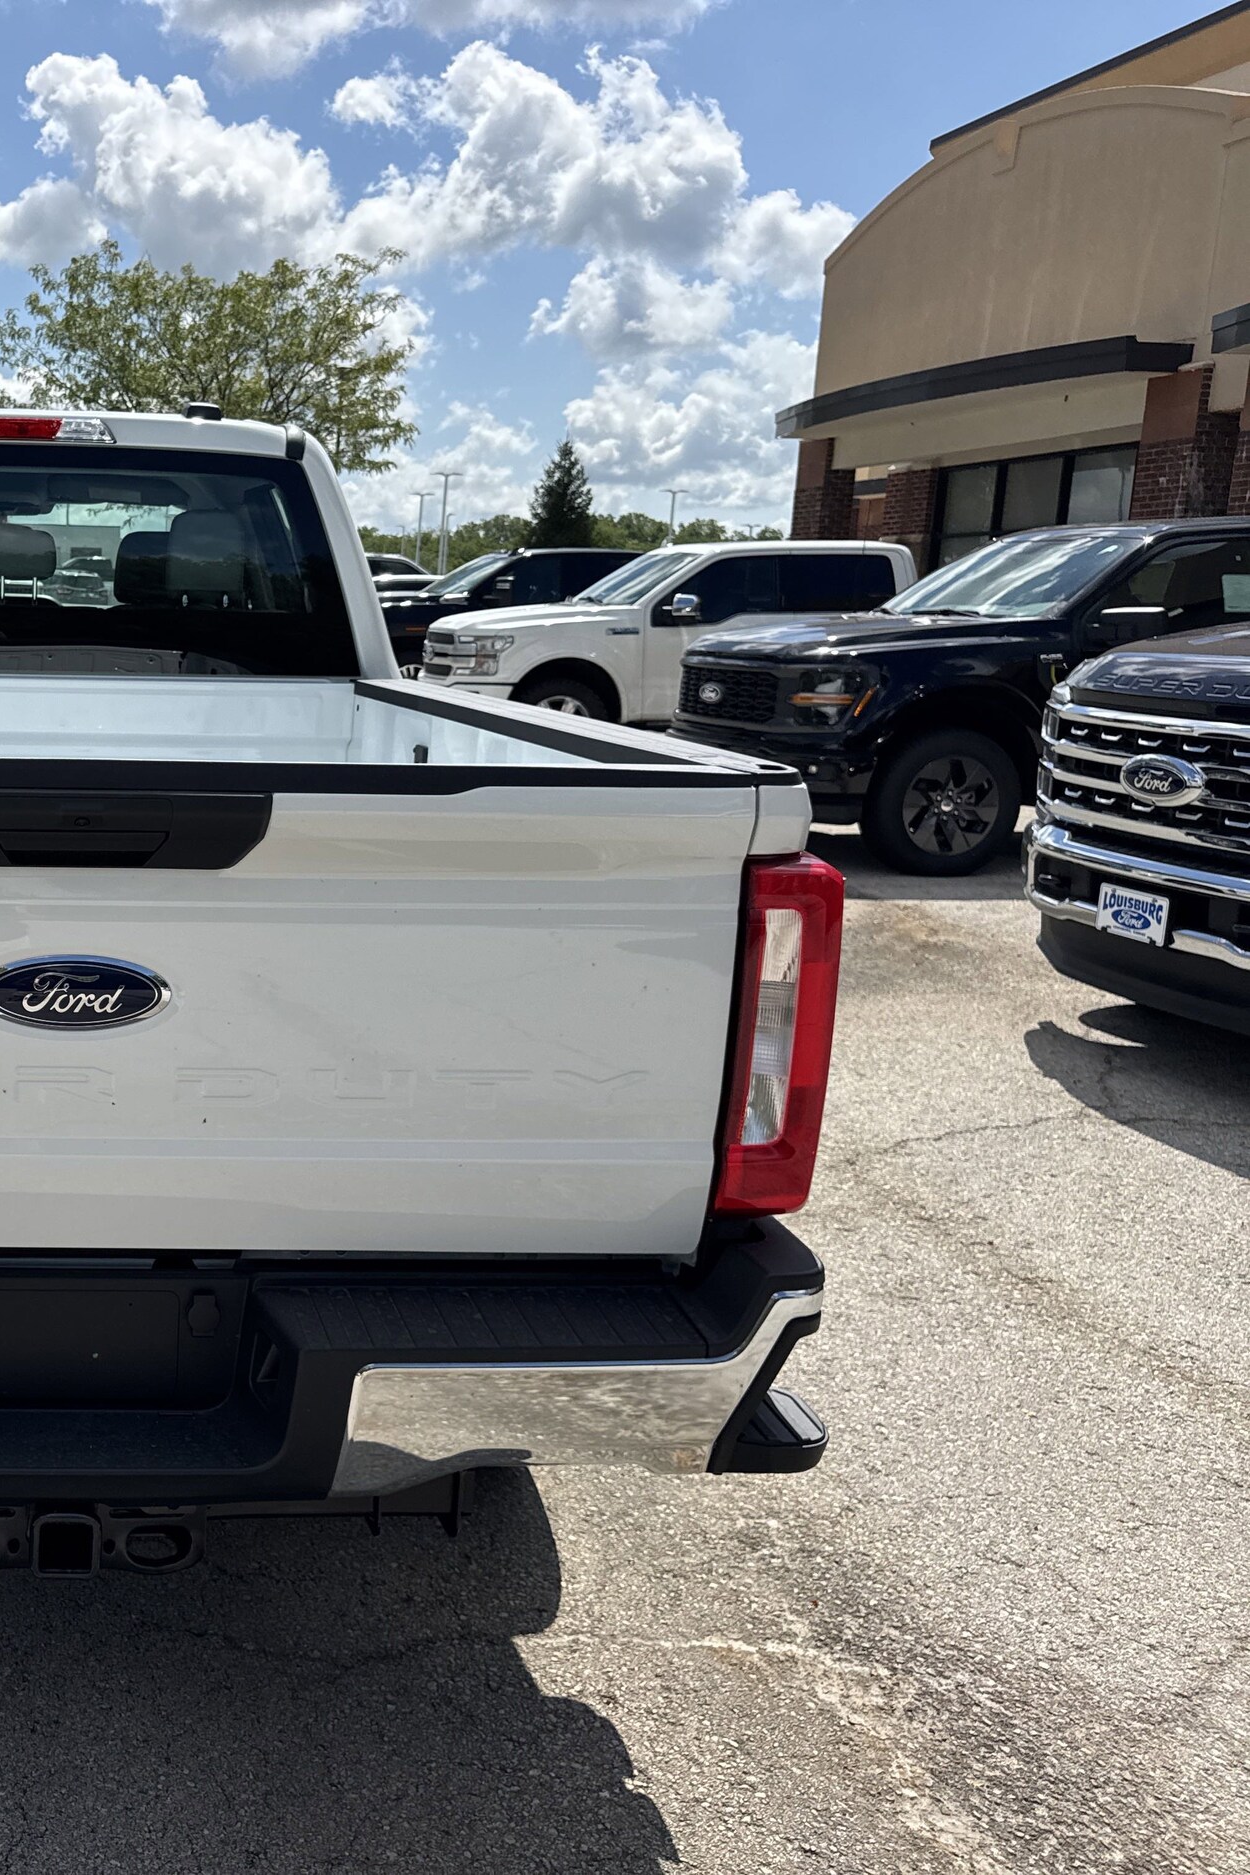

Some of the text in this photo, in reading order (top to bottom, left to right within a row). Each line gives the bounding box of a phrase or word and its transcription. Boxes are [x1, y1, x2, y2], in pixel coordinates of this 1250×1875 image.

[1095, 673, 1204, 696] SUPER
[1133, 767, 1171, 793] Ford
[1102, 890, 1164, 926] LOUISBURG
[1117, 909, 1144, 928] Ford
[22, 971, 126, 1014] Ford
[173, 1066, 650, 1109] DUTY
